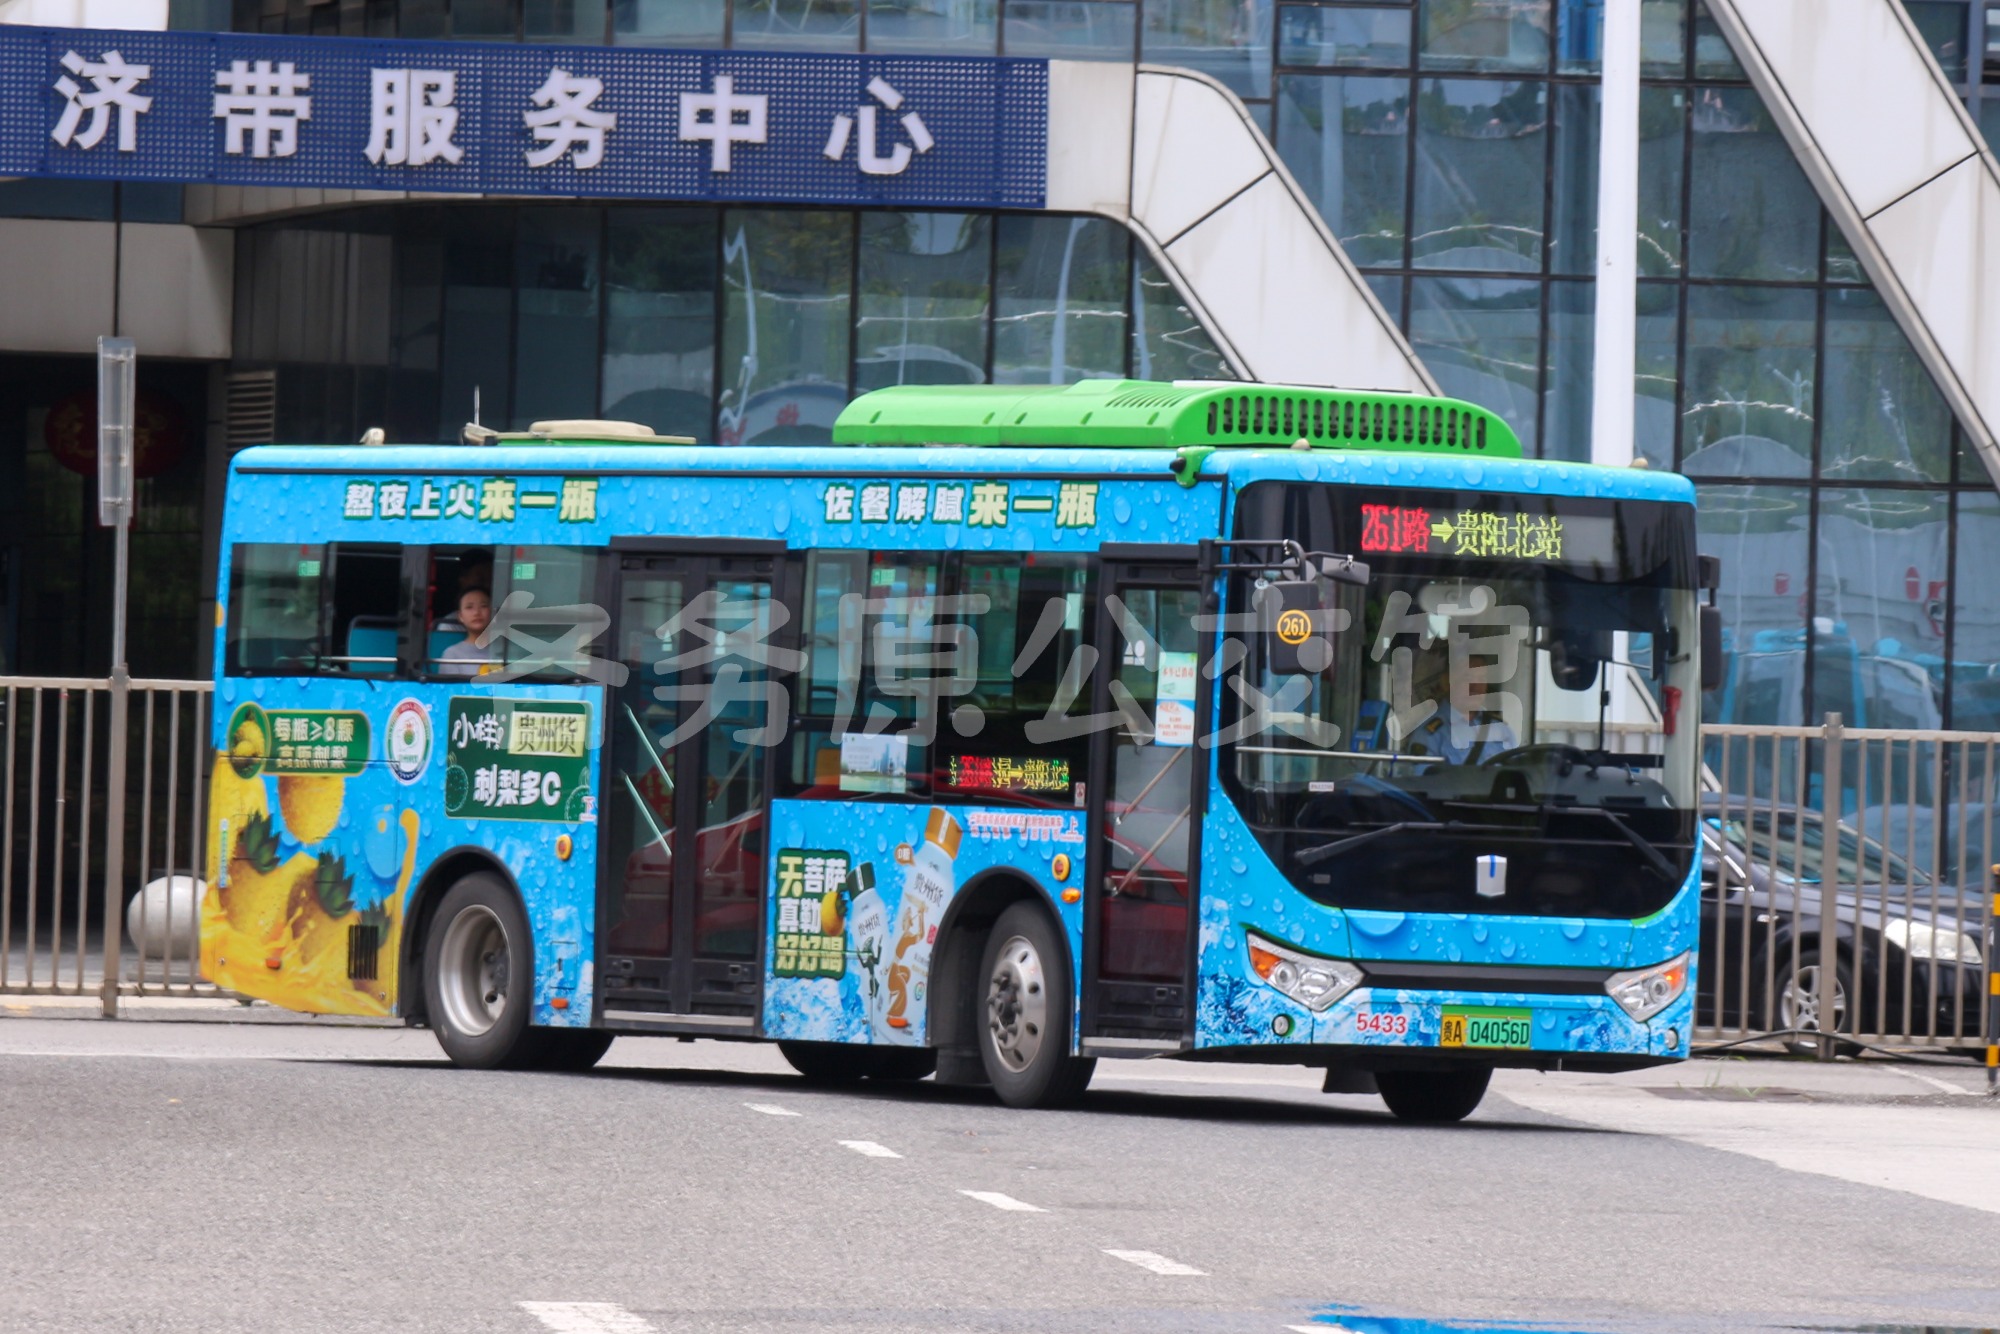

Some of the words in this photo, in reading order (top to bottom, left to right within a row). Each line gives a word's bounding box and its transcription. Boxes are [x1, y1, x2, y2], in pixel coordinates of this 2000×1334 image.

[51, 49, 935, 175] 济带服务中心
[344, 479, 599, 521] 熬夜上火来一瓶
[825, 482, 1099, 526] 佐餐解腻来一瓶
[1361, 504, 1431, 553] 261路
[1454, 509, 1564, 560] 贵阳北站
[1283, 617, 1306, 636] 261
[472, 763, 563, 808] 刺梨多C
[1356, 1013, 1407, 1035] 5433
